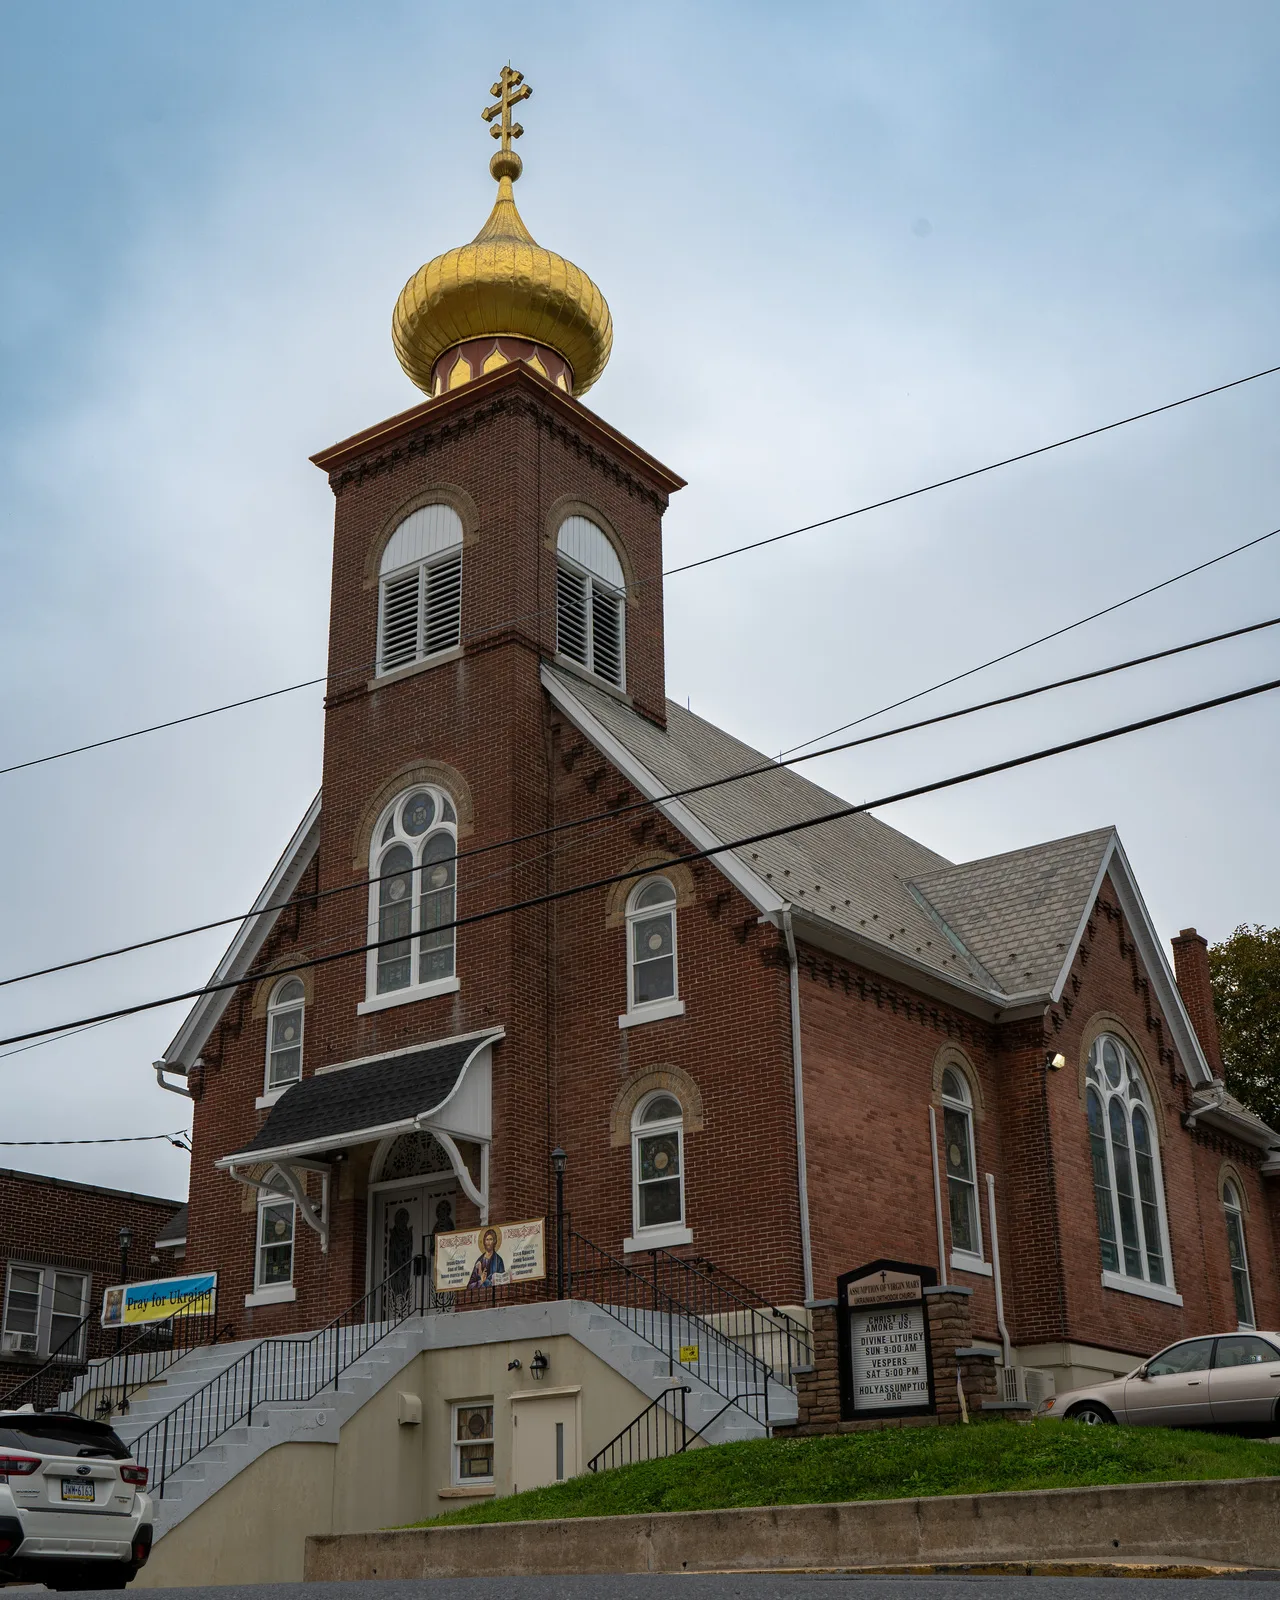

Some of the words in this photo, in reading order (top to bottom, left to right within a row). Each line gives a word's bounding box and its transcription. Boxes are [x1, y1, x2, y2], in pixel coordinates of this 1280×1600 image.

[849, 1284, 880, 1296] ASSUMPTION
[880, 1283, 887, 1292] OF
[887, 1282, 905, 1291] VIRGIN
[905, 1280, 919, 1289] MARY
[127, 1297, 149, 1312] Pray
[152, 1292, 166, 1307] for
[169, 1288, 211, 1305] Ukraine
[854, 1296, 875, 1304] UKRAINIAN
[876, 1293, 898, 1302] ORTHODOX
[899, 1292, 916, 1300] CHURCH
[868, 1314, 896, 1325] CHRIST
[900, 1313, 908, 1322] IS
[866, 1323, 893, 1332] AMONG
[898, 1320, 911, 1329] US!
[861, 1335, 886, 1345] DIVINE
[890, 1332, 923, 1343] LITURGY
[865, 1346, 880, 1355] SUN
[884, 1344, 902, 1354] 9:00
[904, 1343, 916, 1352] AM
[872, 1357, 907, 1368] VESPERS
[866, 1369, 880, 1378] SAT
[885, 1367, 903, 1377] 5:00
[906, 1366, 919, 1375] PM
[883, 1391, 902, 1400] .ORG
